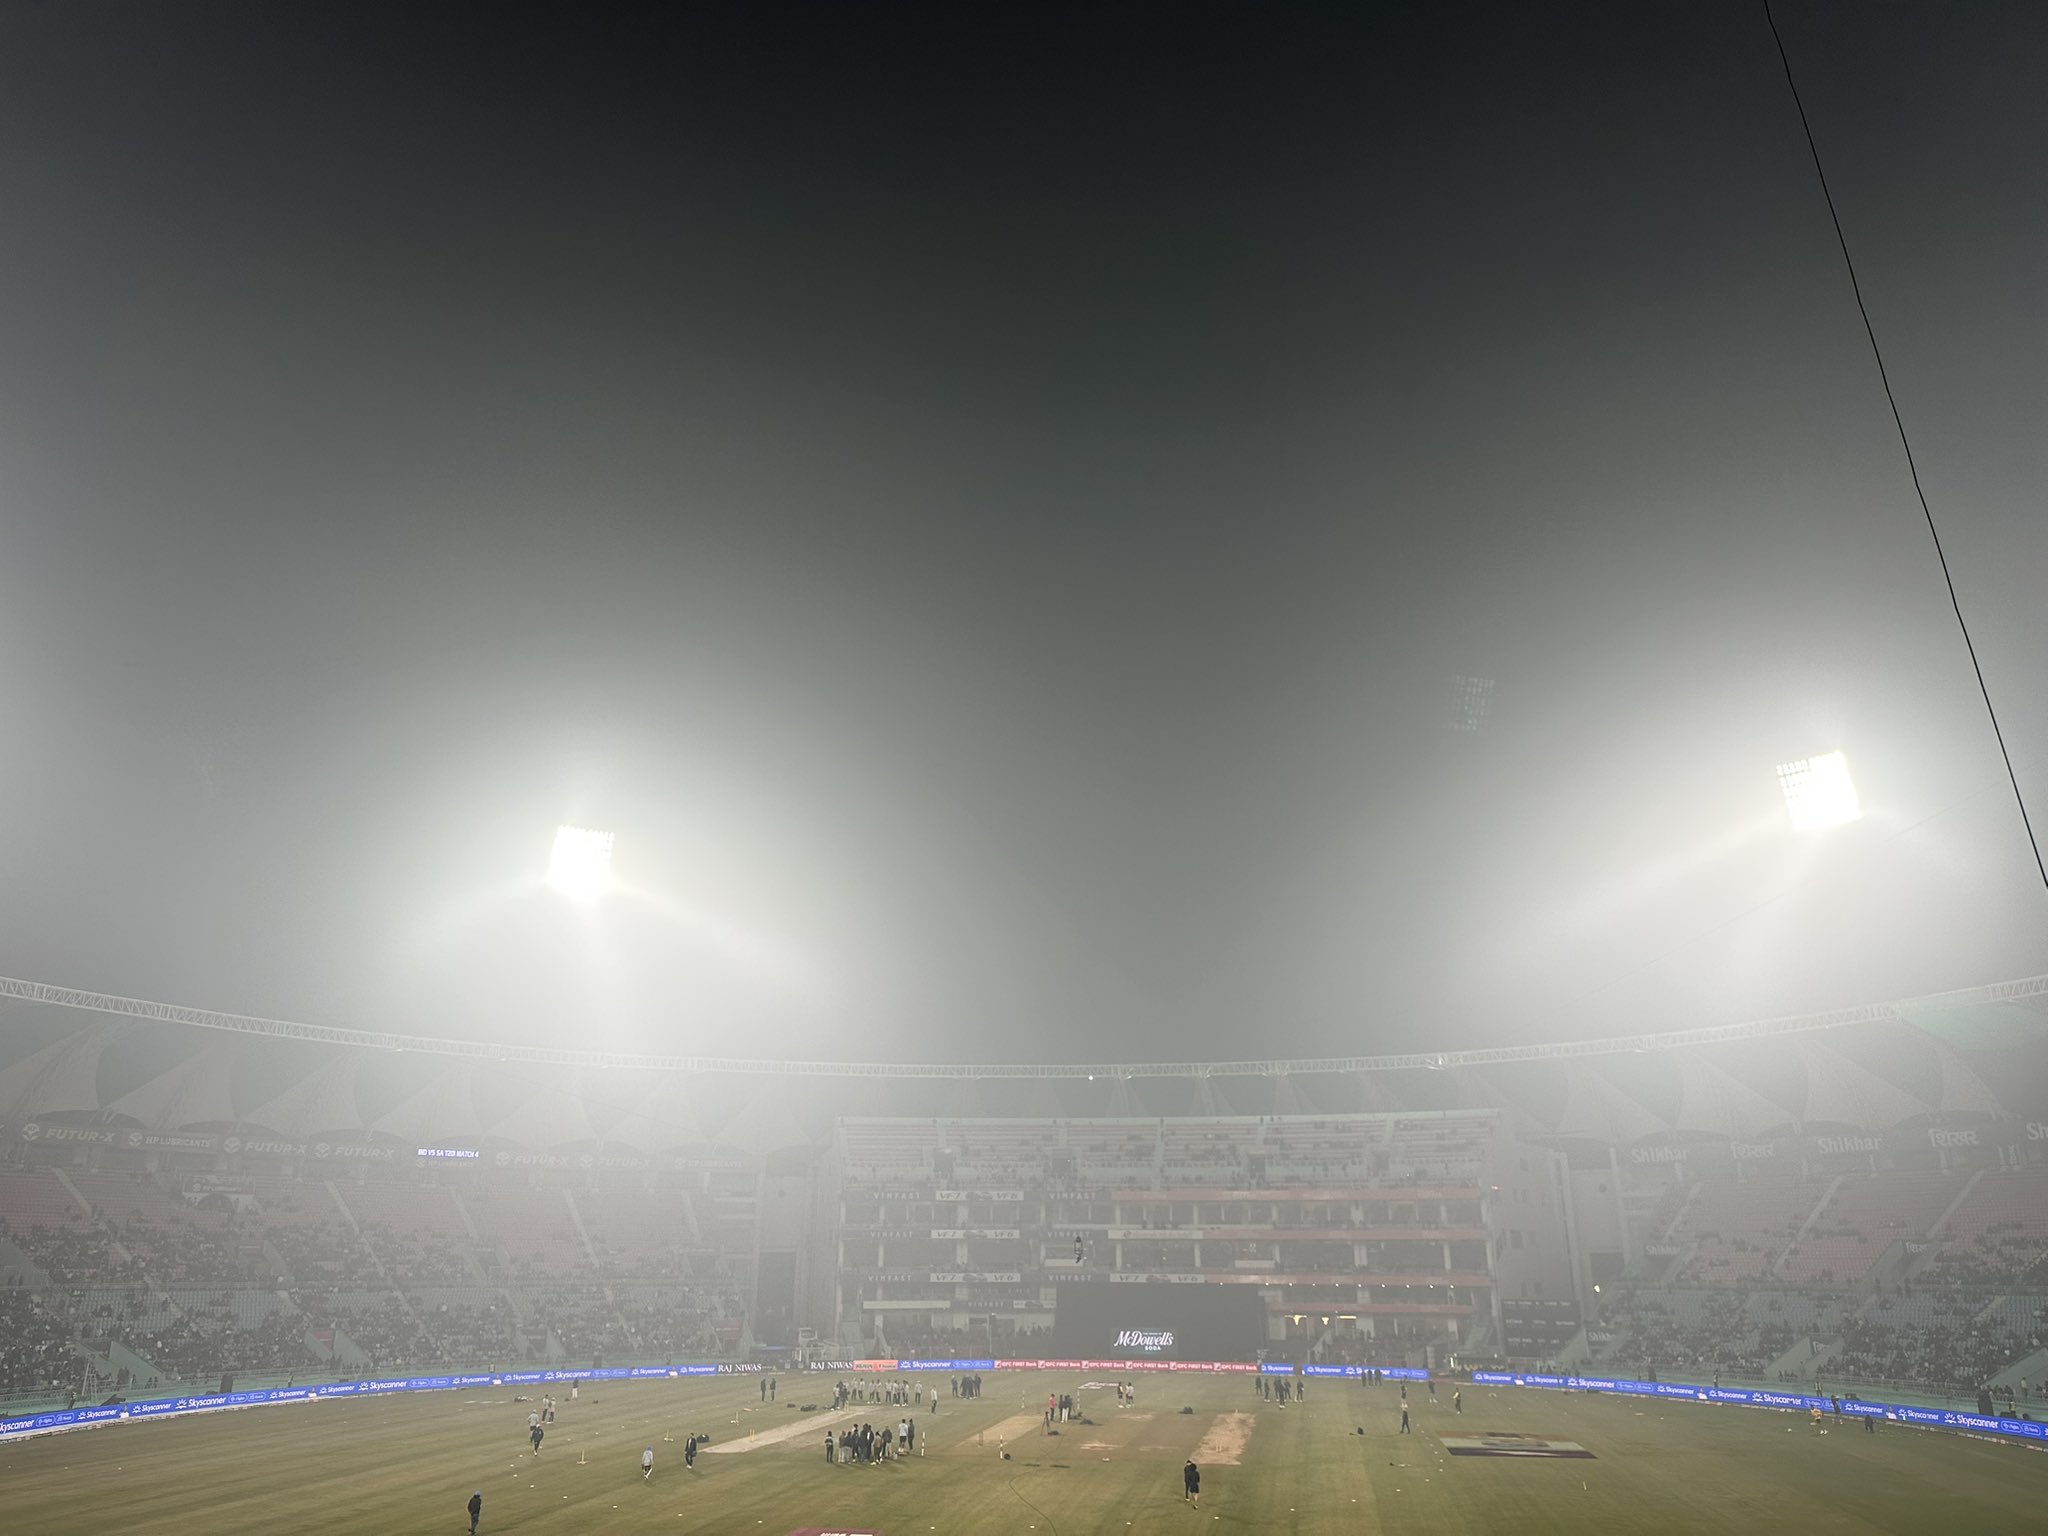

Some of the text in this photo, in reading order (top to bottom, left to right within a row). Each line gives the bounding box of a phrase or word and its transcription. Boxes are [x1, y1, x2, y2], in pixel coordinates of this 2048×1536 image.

[45, 1127, 115, 1143] FUTUR-X
[245, 1142, 307, 1155] FUTUR-X
[1816, 1135, 1883, 1154] Shikhar
[335, 1145, 395, 1159] FUTUR-X
[873, 1192, 921, 1200] VINFAST
[1050, 1192, 1096, 1200] VINFAST
[1113, 1330, 1174, 1347] McDowell's
[718, 1363, 762, 1373] RAJ NIWAS
[810, 1361, 825, 1370] RAJ
[828, 1361, 853, 1370] NIWAS
[913, 1360, 951, 1370] Skyscanner
[461, 1375, 490, 1385] Skyscanner
[512, 1373, 540, 1382] Skyscanner
[555, 1370, 591, 1380] Skyscanner
[327, 1384, 355, 1394] Skyscanner
[369, 1380, 407, 1391] Skyscanner
[1579, 1378, 1614, 1389] Skyscanner
[278, 1389, 306, 1400] Skyscanner
[1718, 1391, 1747, 1400] Skyscanner
[141, 1402, 171, 1414] Skyscanner
[188, 1396, 226, 1409] Skyscanner
[86, 1408, 117, 1420] Skyscanner
[1853, 1403, 1883, 1414] Skyscanner
[1956, 1414, 1999, 1429] Skyscanner
